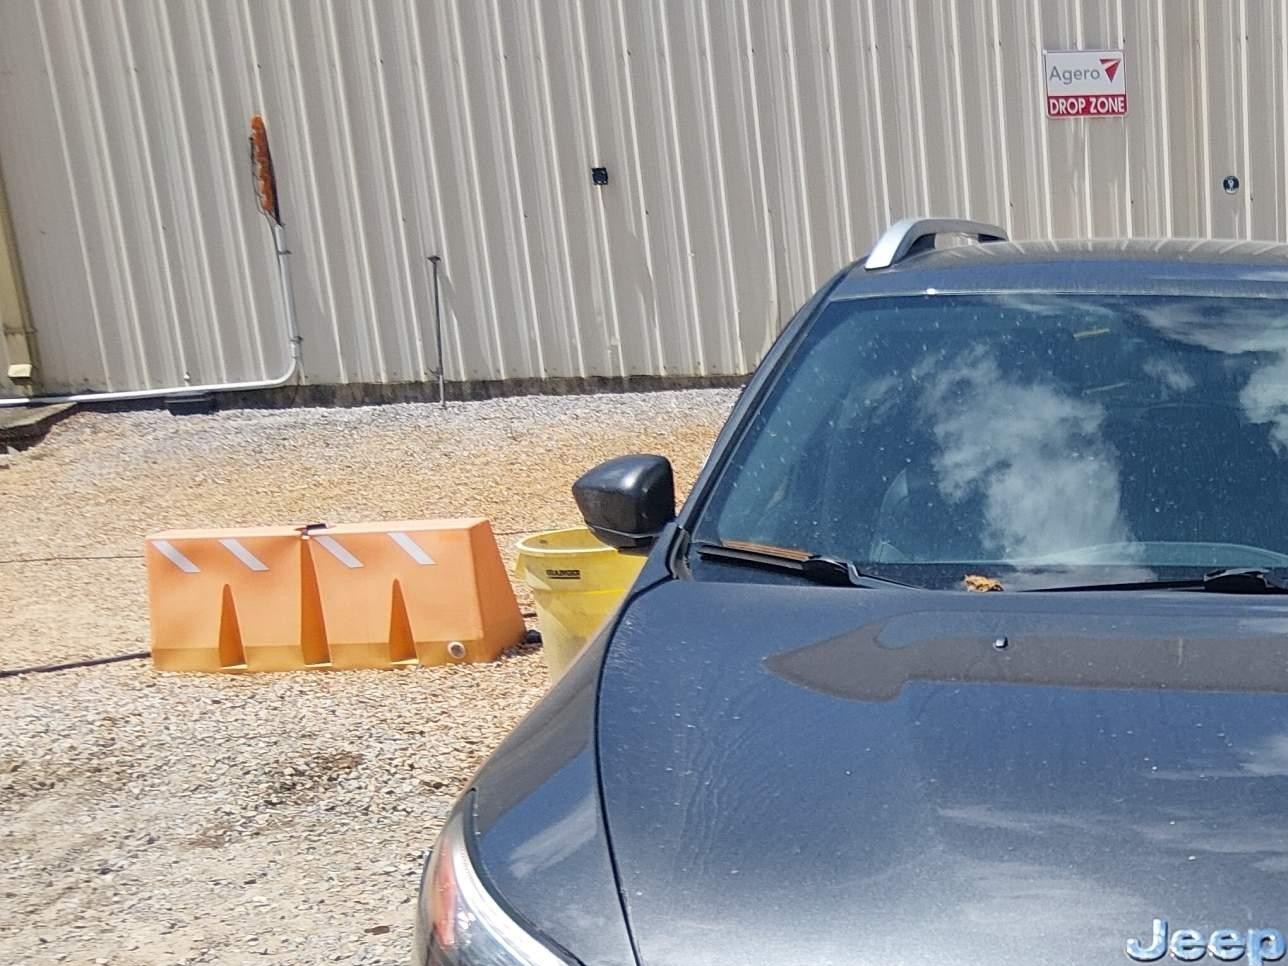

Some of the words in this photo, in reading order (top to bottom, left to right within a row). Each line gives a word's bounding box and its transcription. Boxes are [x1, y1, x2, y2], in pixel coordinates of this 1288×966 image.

[1049, 65, 1101, 85] Agero
[1049, 98, 1086, 115] DROP
[1089, 97, 1125, 114] ZONE
